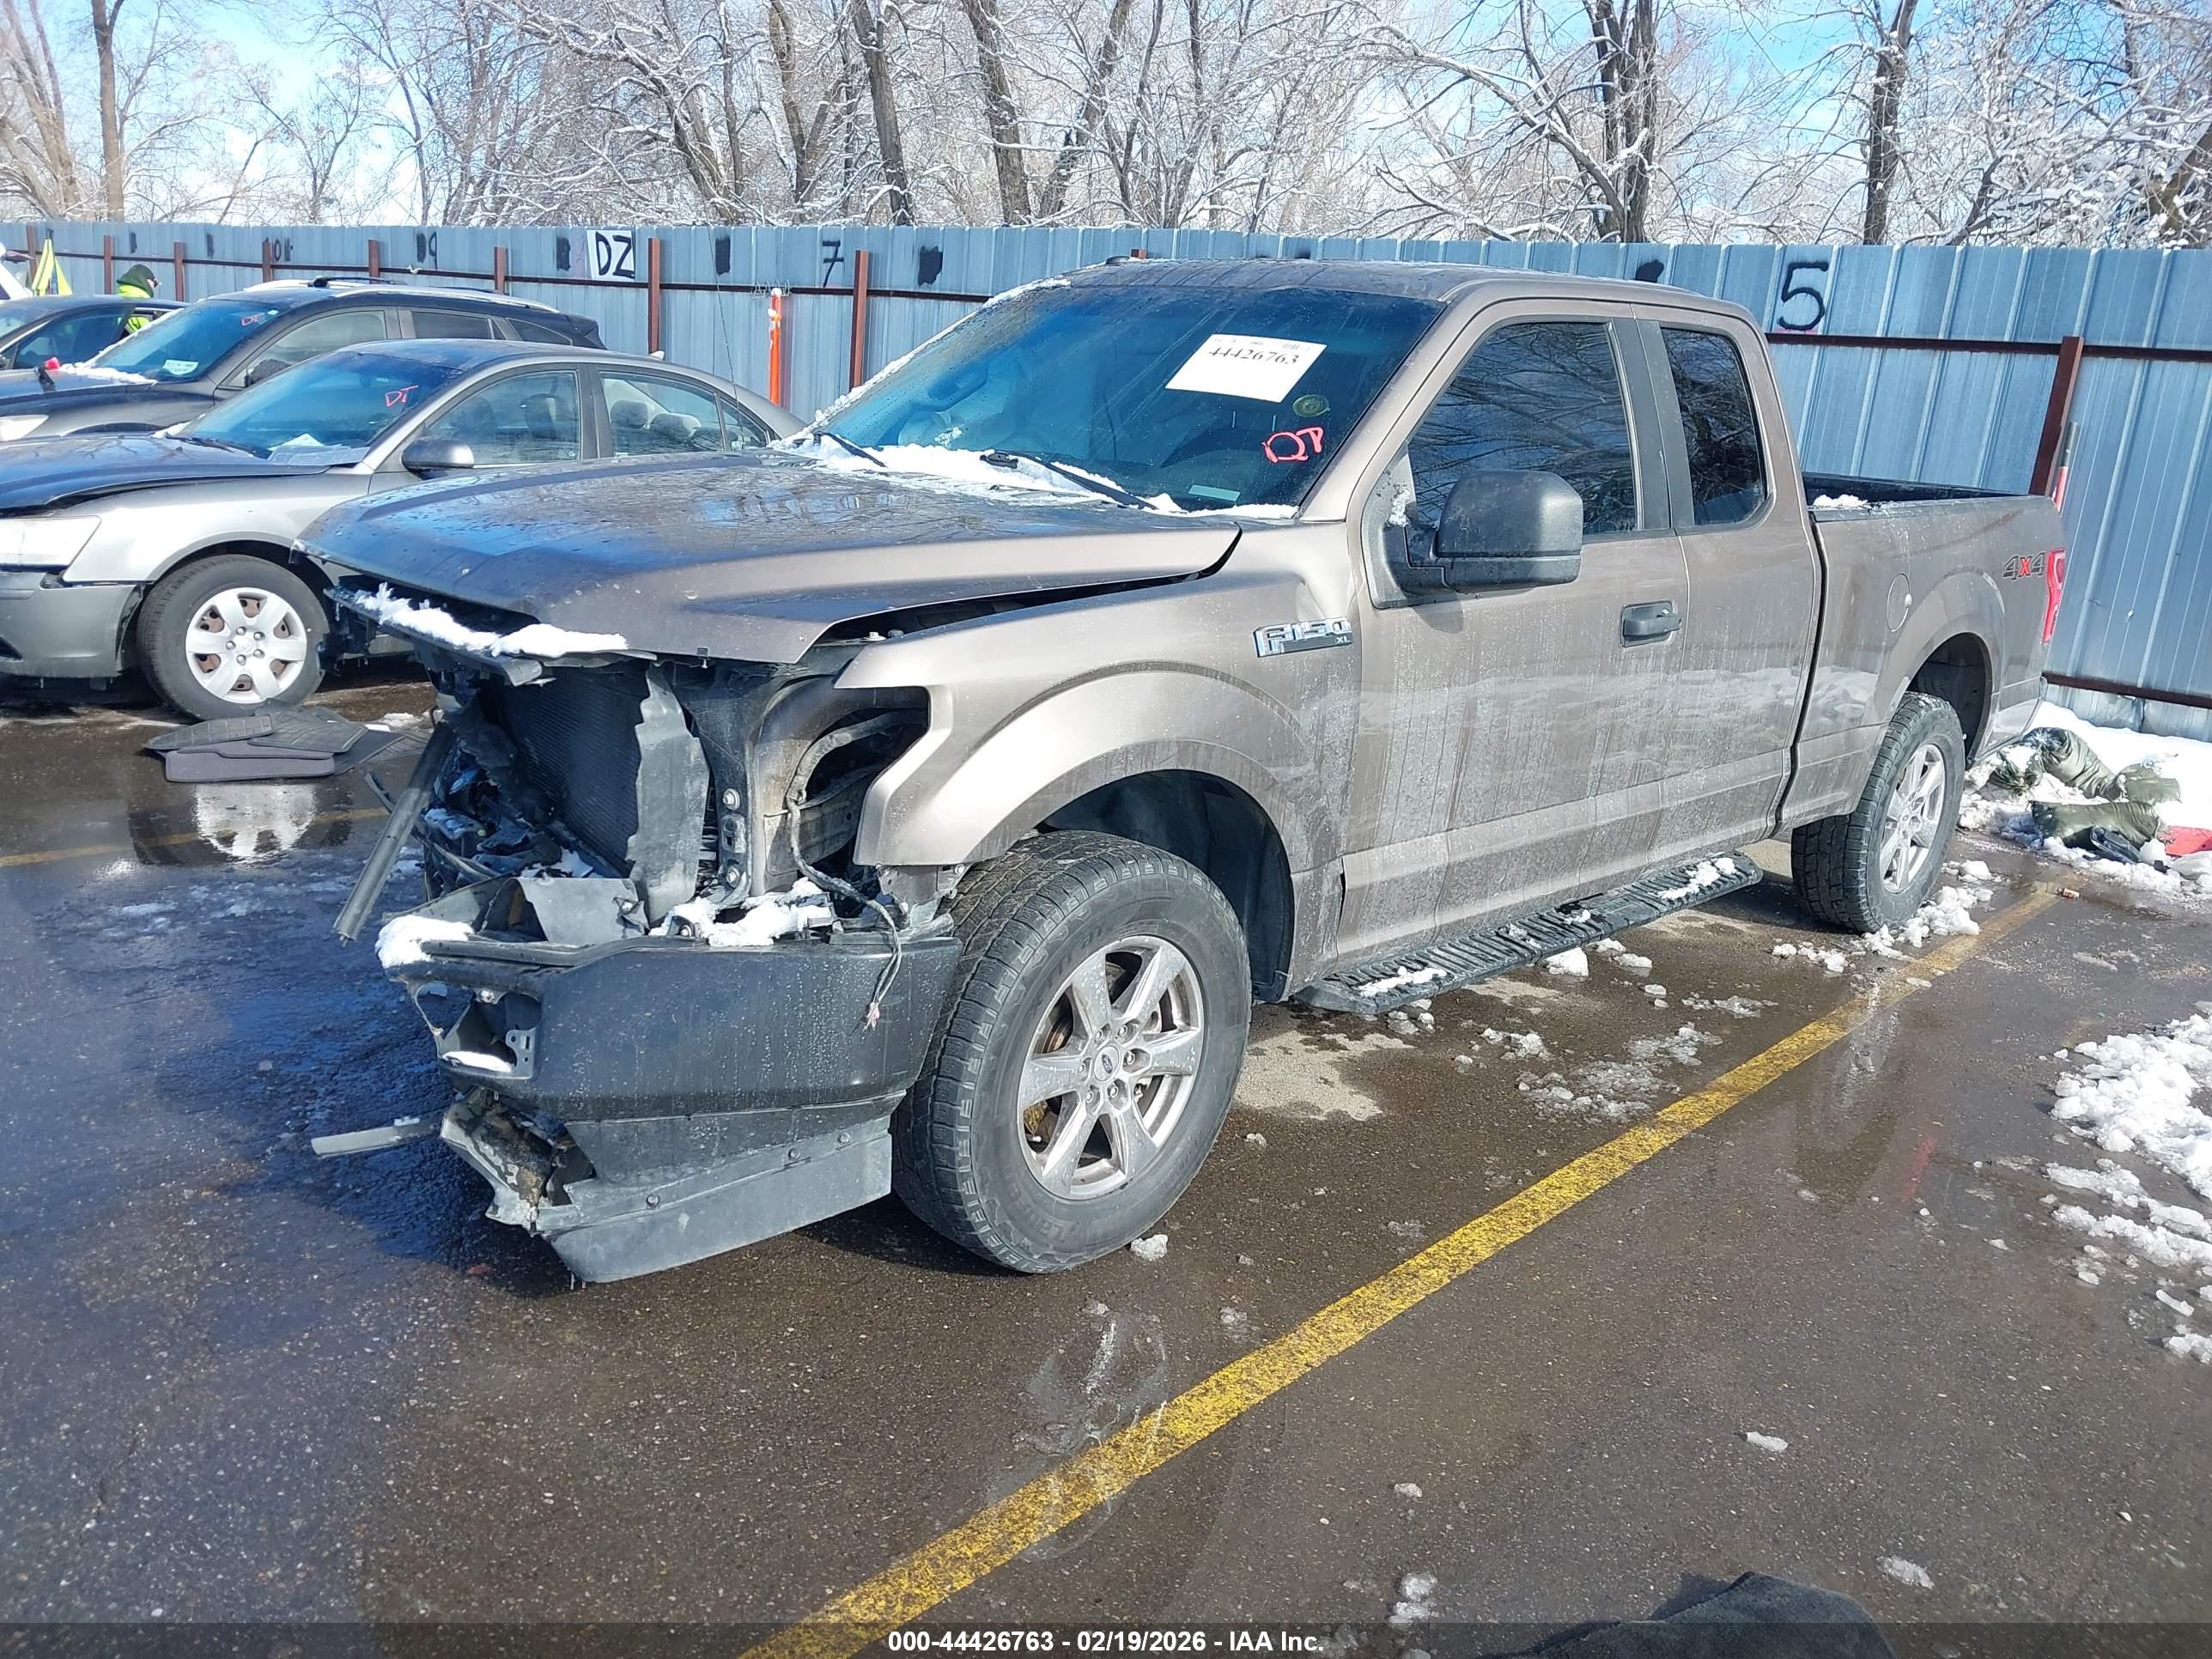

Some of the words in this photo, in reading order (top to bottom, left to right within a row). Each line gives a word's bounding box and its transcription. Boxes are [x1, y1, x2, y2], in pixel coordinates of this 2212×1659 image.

[822, 240, 845, 289] 7
[1777, 261, 1828, 332] 5
[1207, 346, 1299, 365] 44426763
[1335, 635, 1352, 645] XL
